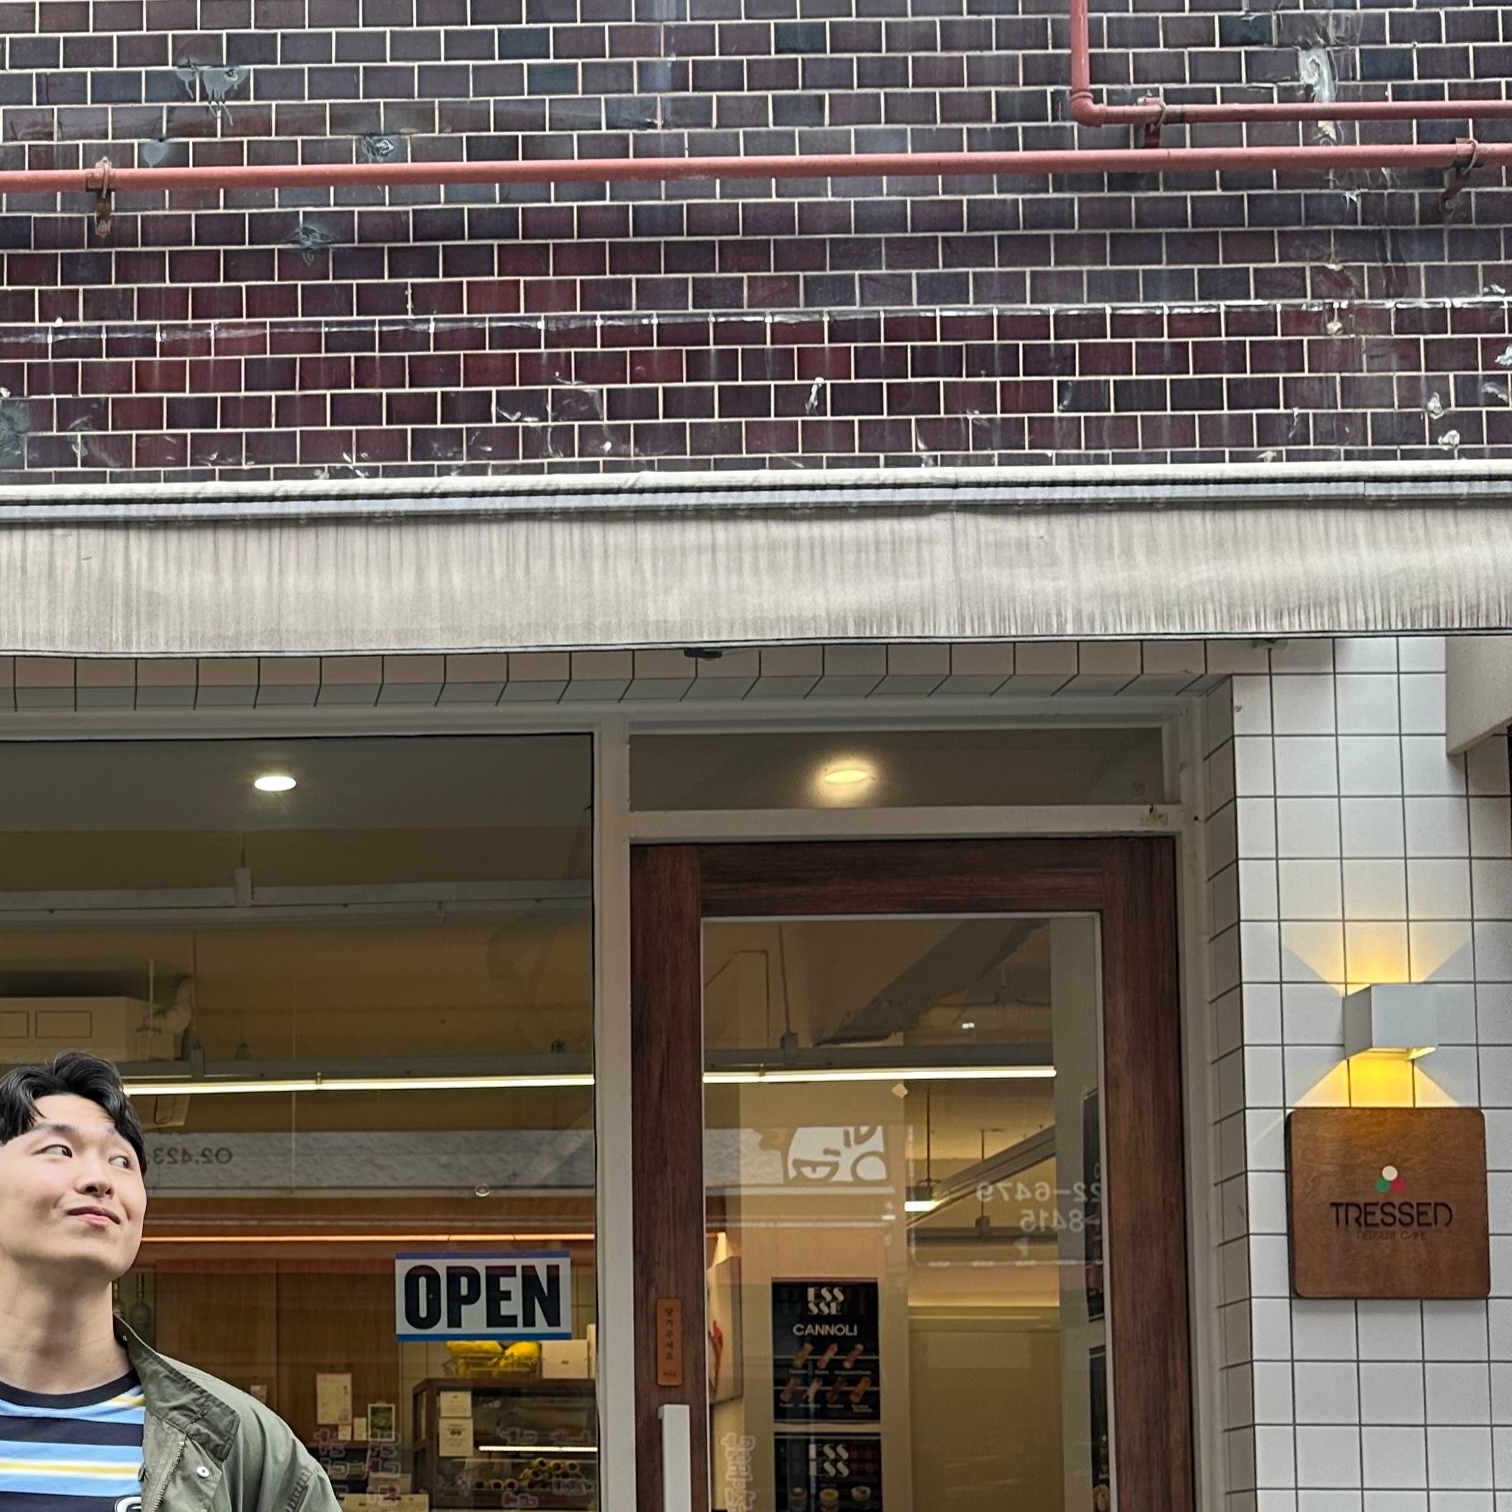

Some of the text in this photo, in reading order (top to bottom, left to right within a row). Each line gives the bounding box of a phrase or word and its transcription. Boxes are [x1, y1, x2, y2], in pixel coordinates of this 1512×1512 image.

[1329, 1201, 1453, 1227] TRESSED
[1356, 1231, 1396, 1240] DESSERT
[404, 1264, 561, 1330] OPEN
[792, 1323, 858, 1336] CANNOLI
